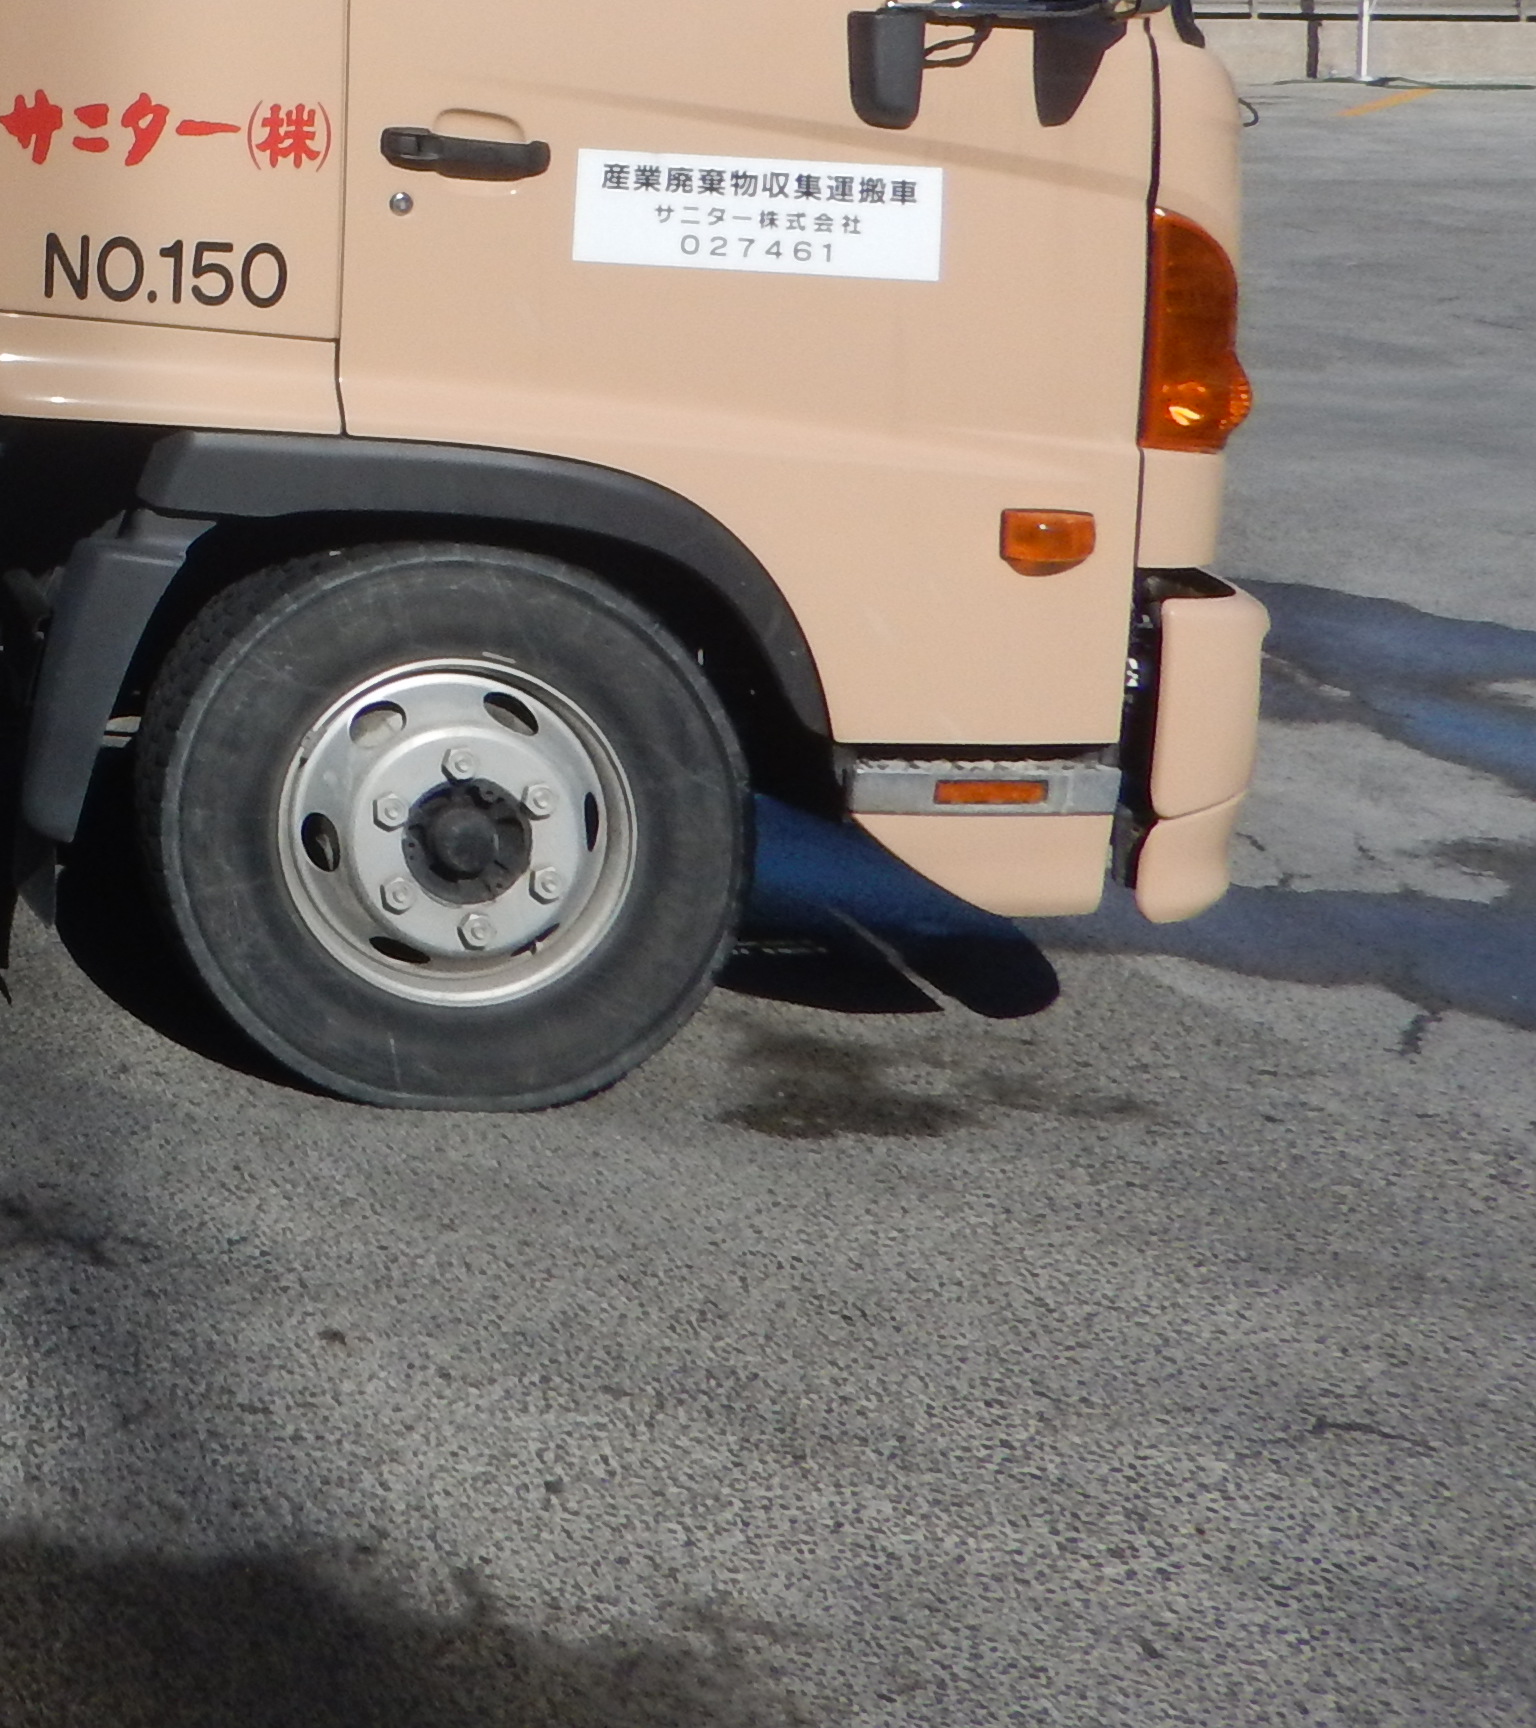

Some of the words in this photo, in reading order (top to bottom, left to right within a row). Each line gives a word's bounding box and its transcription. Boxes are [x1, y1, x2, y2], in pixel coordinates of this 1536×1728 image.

[602, 163, 917, 204] 産業廃棄物収集運搬車
[655, 205, 861, 234] サニター株式会社
[680, 234, 833, 262] 027461
[44, 232, 288, 308] NO.150
